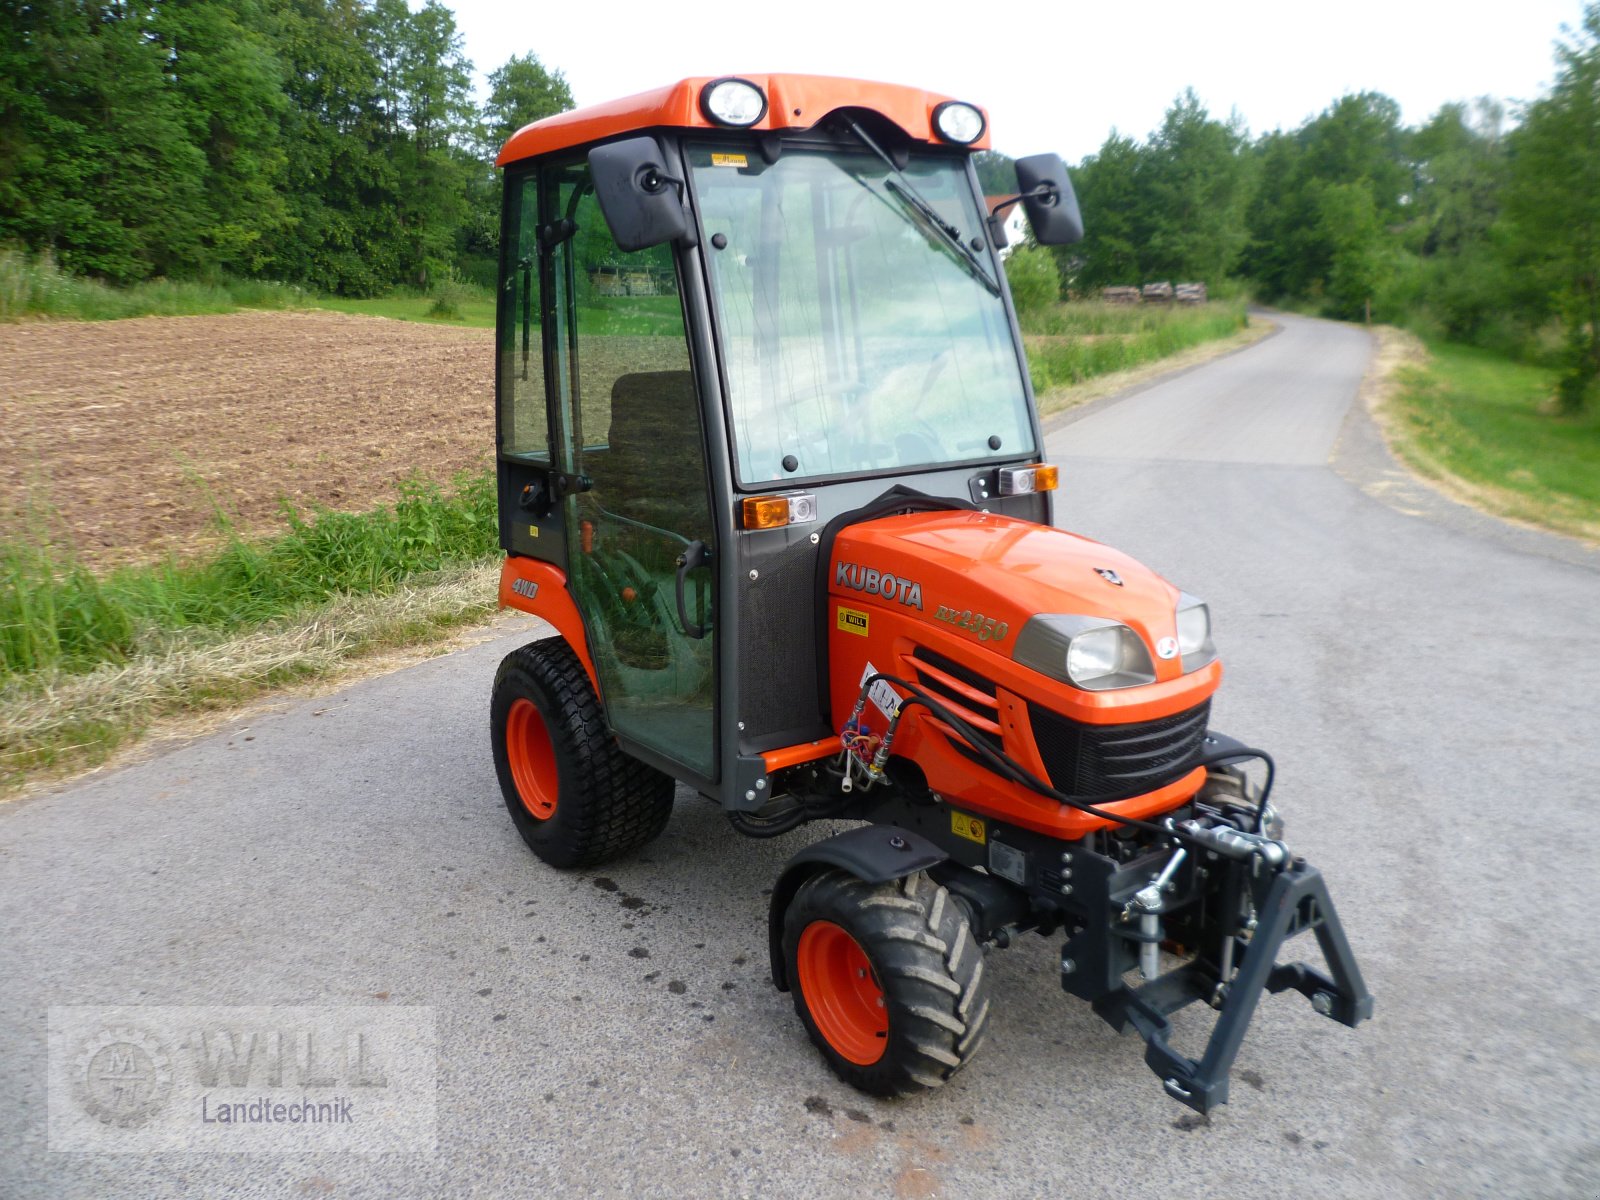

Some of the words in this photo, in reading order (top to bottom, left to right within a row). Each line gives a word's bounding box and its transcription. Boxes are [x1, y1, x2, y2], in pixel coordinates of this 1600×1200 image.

[512, 578, 539, 599] 4WD
[836, 561, 924, 611] KUBOTA
[848, 615, 864, 626] WILL
